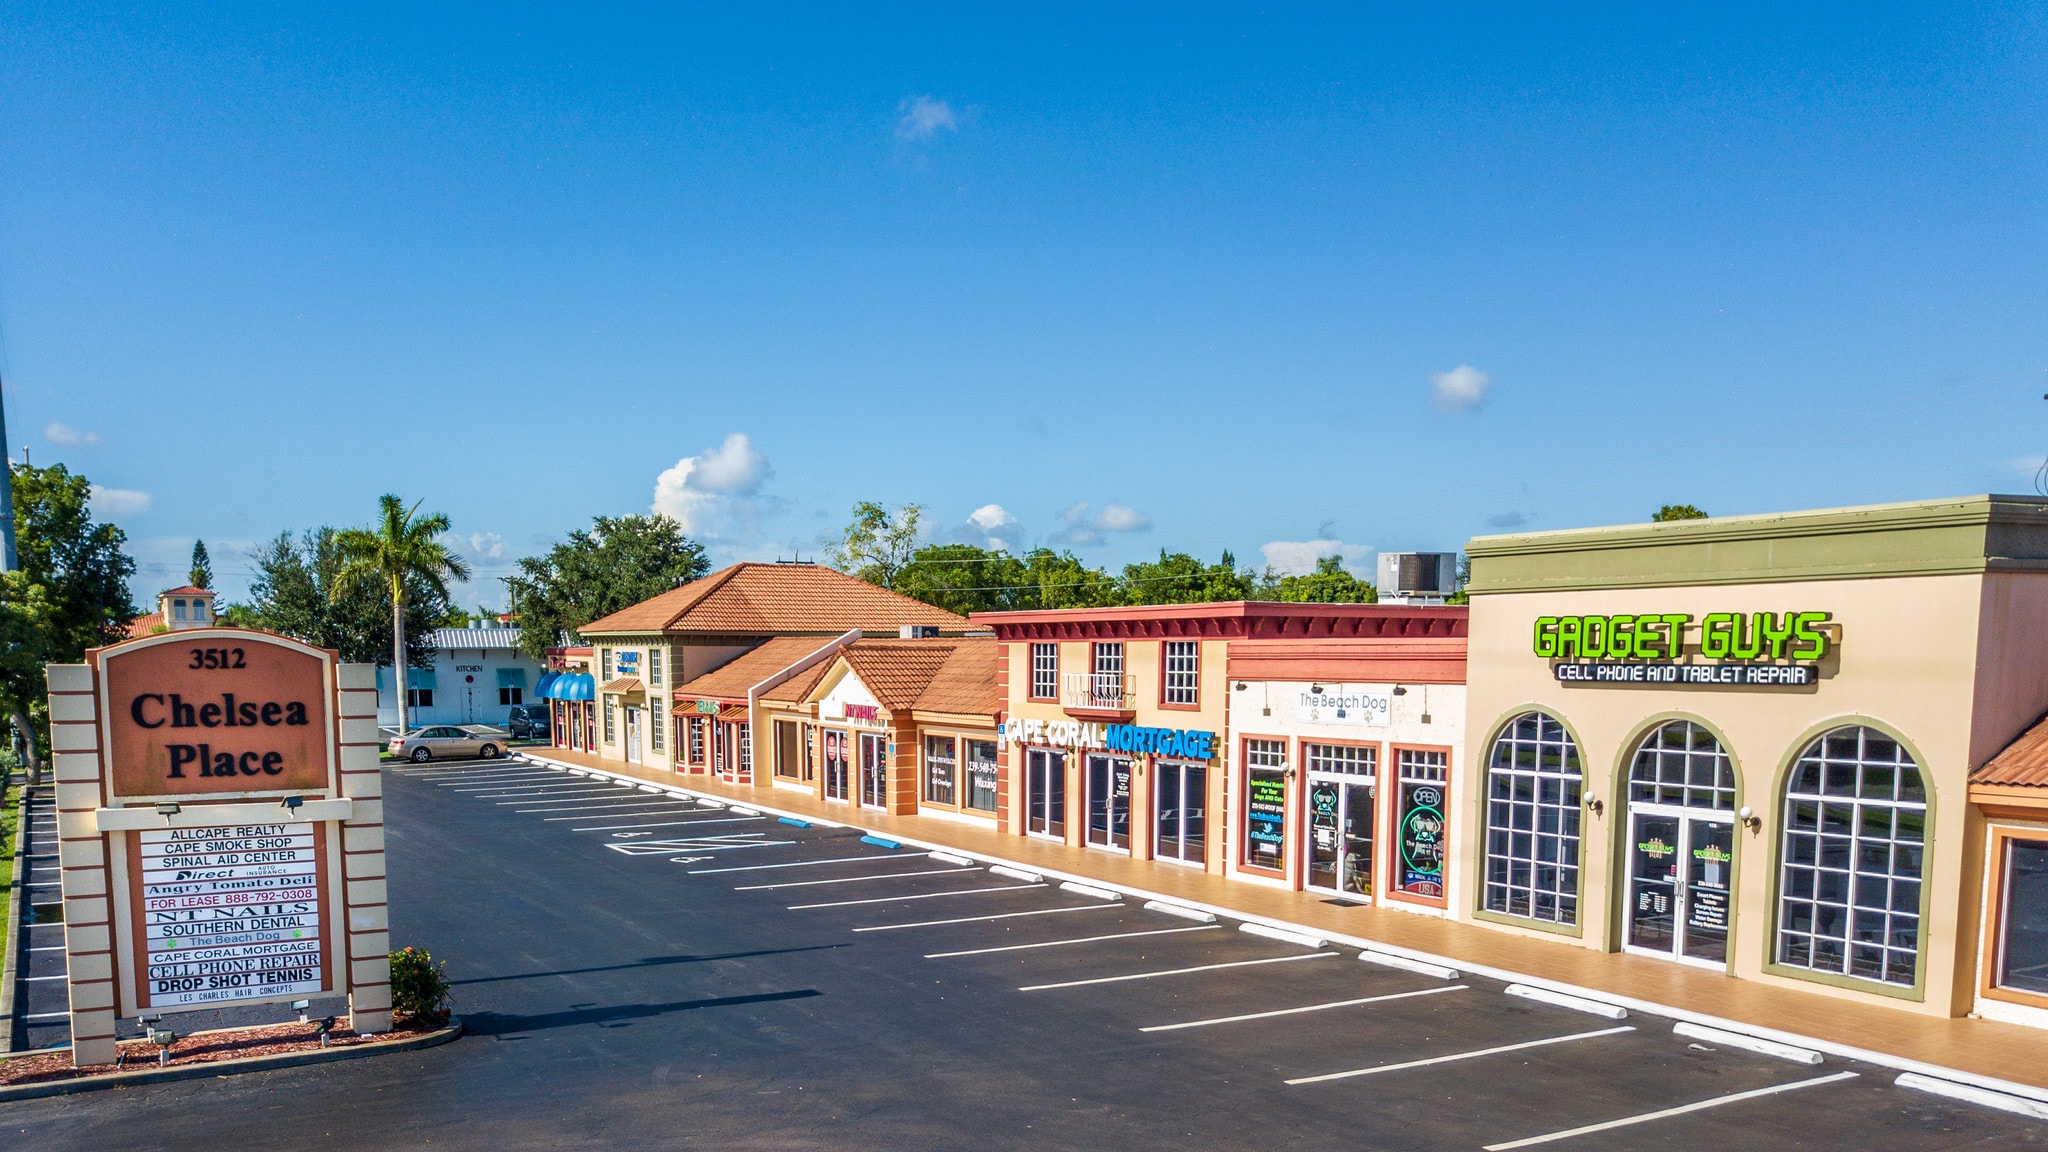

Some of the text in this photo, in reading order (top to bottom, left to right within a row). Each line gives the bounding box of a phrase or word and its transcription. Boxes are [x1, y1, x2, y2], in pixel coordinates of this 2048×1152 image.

[1533, 612, 1828, 660] GADGET GUYS
[189, 648, 246, 670] 3512
[1558, 664, 1807, 683] CELL PHONE AND TABLET REPAIR
[131, 693, 309, 728] Chelsea
[856, 705, 877, 720] NAILS
[1300, 693, 1387, 713] The Beach Dog
[1005, 718, 1045, 743] CAPE
[1048, 720, 1104, 748] CORAL
[1105, 724, 1217, 759] MORTGAGE
[165, 743, 283, 778] Place
[974, 776, 997, 792] Waxing
[1415, 790, 1438, 803] OPEN
[171, 825, 286, 840] ALLCAPE REALTY
[164, 838, 292, 854] CAPE SMOKE SHOP
[163, 851, 296, 868] SPINAL AID CENTER
[175, 869, 235, 881] Direct
[246, 868, 287, 876] INSURANCE
[149, 876, 313, 895] Angry Tomato Deli
[1419, 882, 1435, 896] USA
[151, 889, 312, 909] FOR LEASE 888-792-0308
[156, 902, 310, 922] NT NAILS
[163, 916, 305, 936] SOUTHERN DENTAL
[189, 932, 280, 946] The Beach Dog
[154, 942, 315, 963] CAPE CORAL MORTGAGE
[150, 954, 320, 979] CELL PHONE REPAIR
[158, 968, 313, 993] DROP SHOT TENNIS
[179, 985, 293, 1002] LES CHARLES HAIR CONCEPTS
